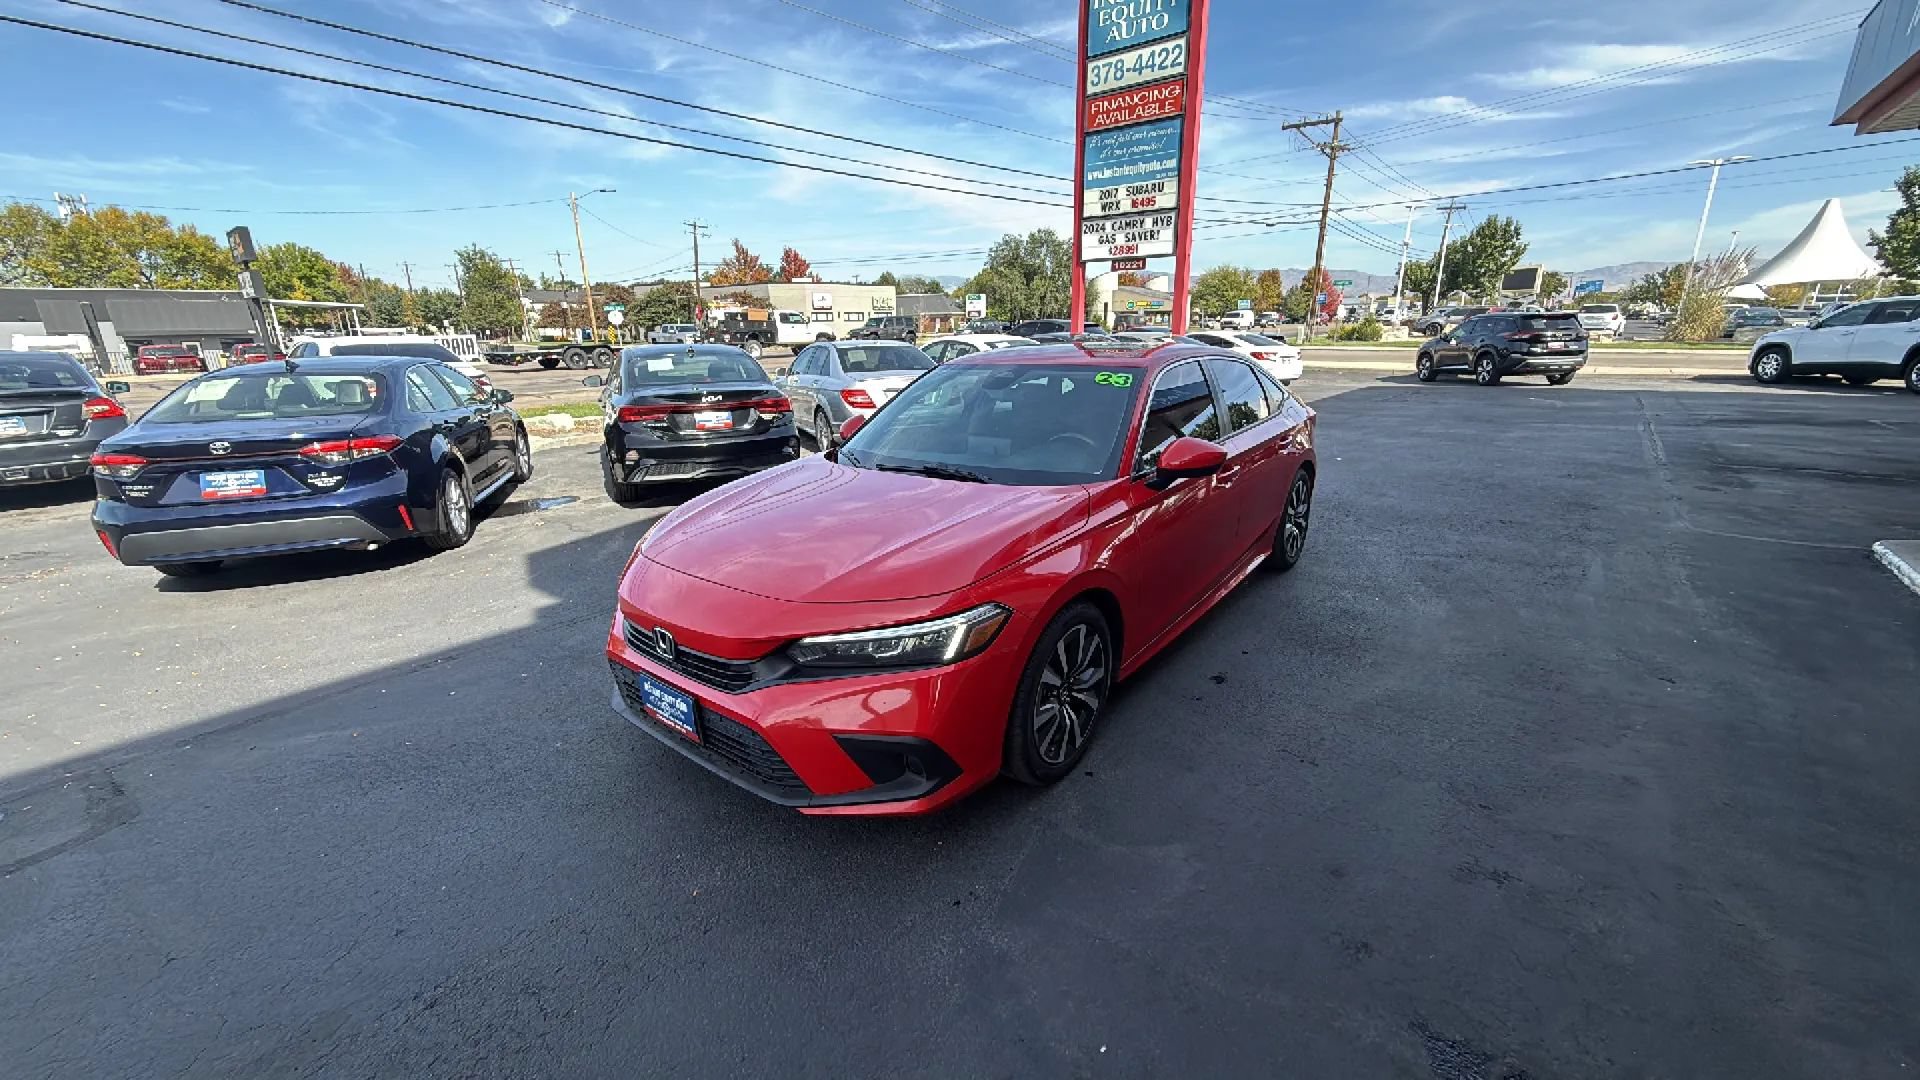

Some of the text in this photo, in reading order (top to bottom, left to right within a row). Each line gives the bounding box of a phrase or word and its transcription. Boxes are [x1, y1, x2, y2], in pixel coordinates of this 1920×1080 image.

[1105, 12, 1169, 44] AUTO
[1091, 44, 1183, 87] 378-4422
[1091, 85, 1181, 115] FINANCING
[1093, 100, 1177, 127] AVAILABLE
[1099, 182, 1165, 201] 2017 SUBARU
[1100, 195, 1157, 213] WRX 16495
[1083, 215, 1173, 235] 2024 CAMRY HYB
[1098, 229, 1161, 245] GAS SAVER!
[1096, 371, 1133, 388] 23
